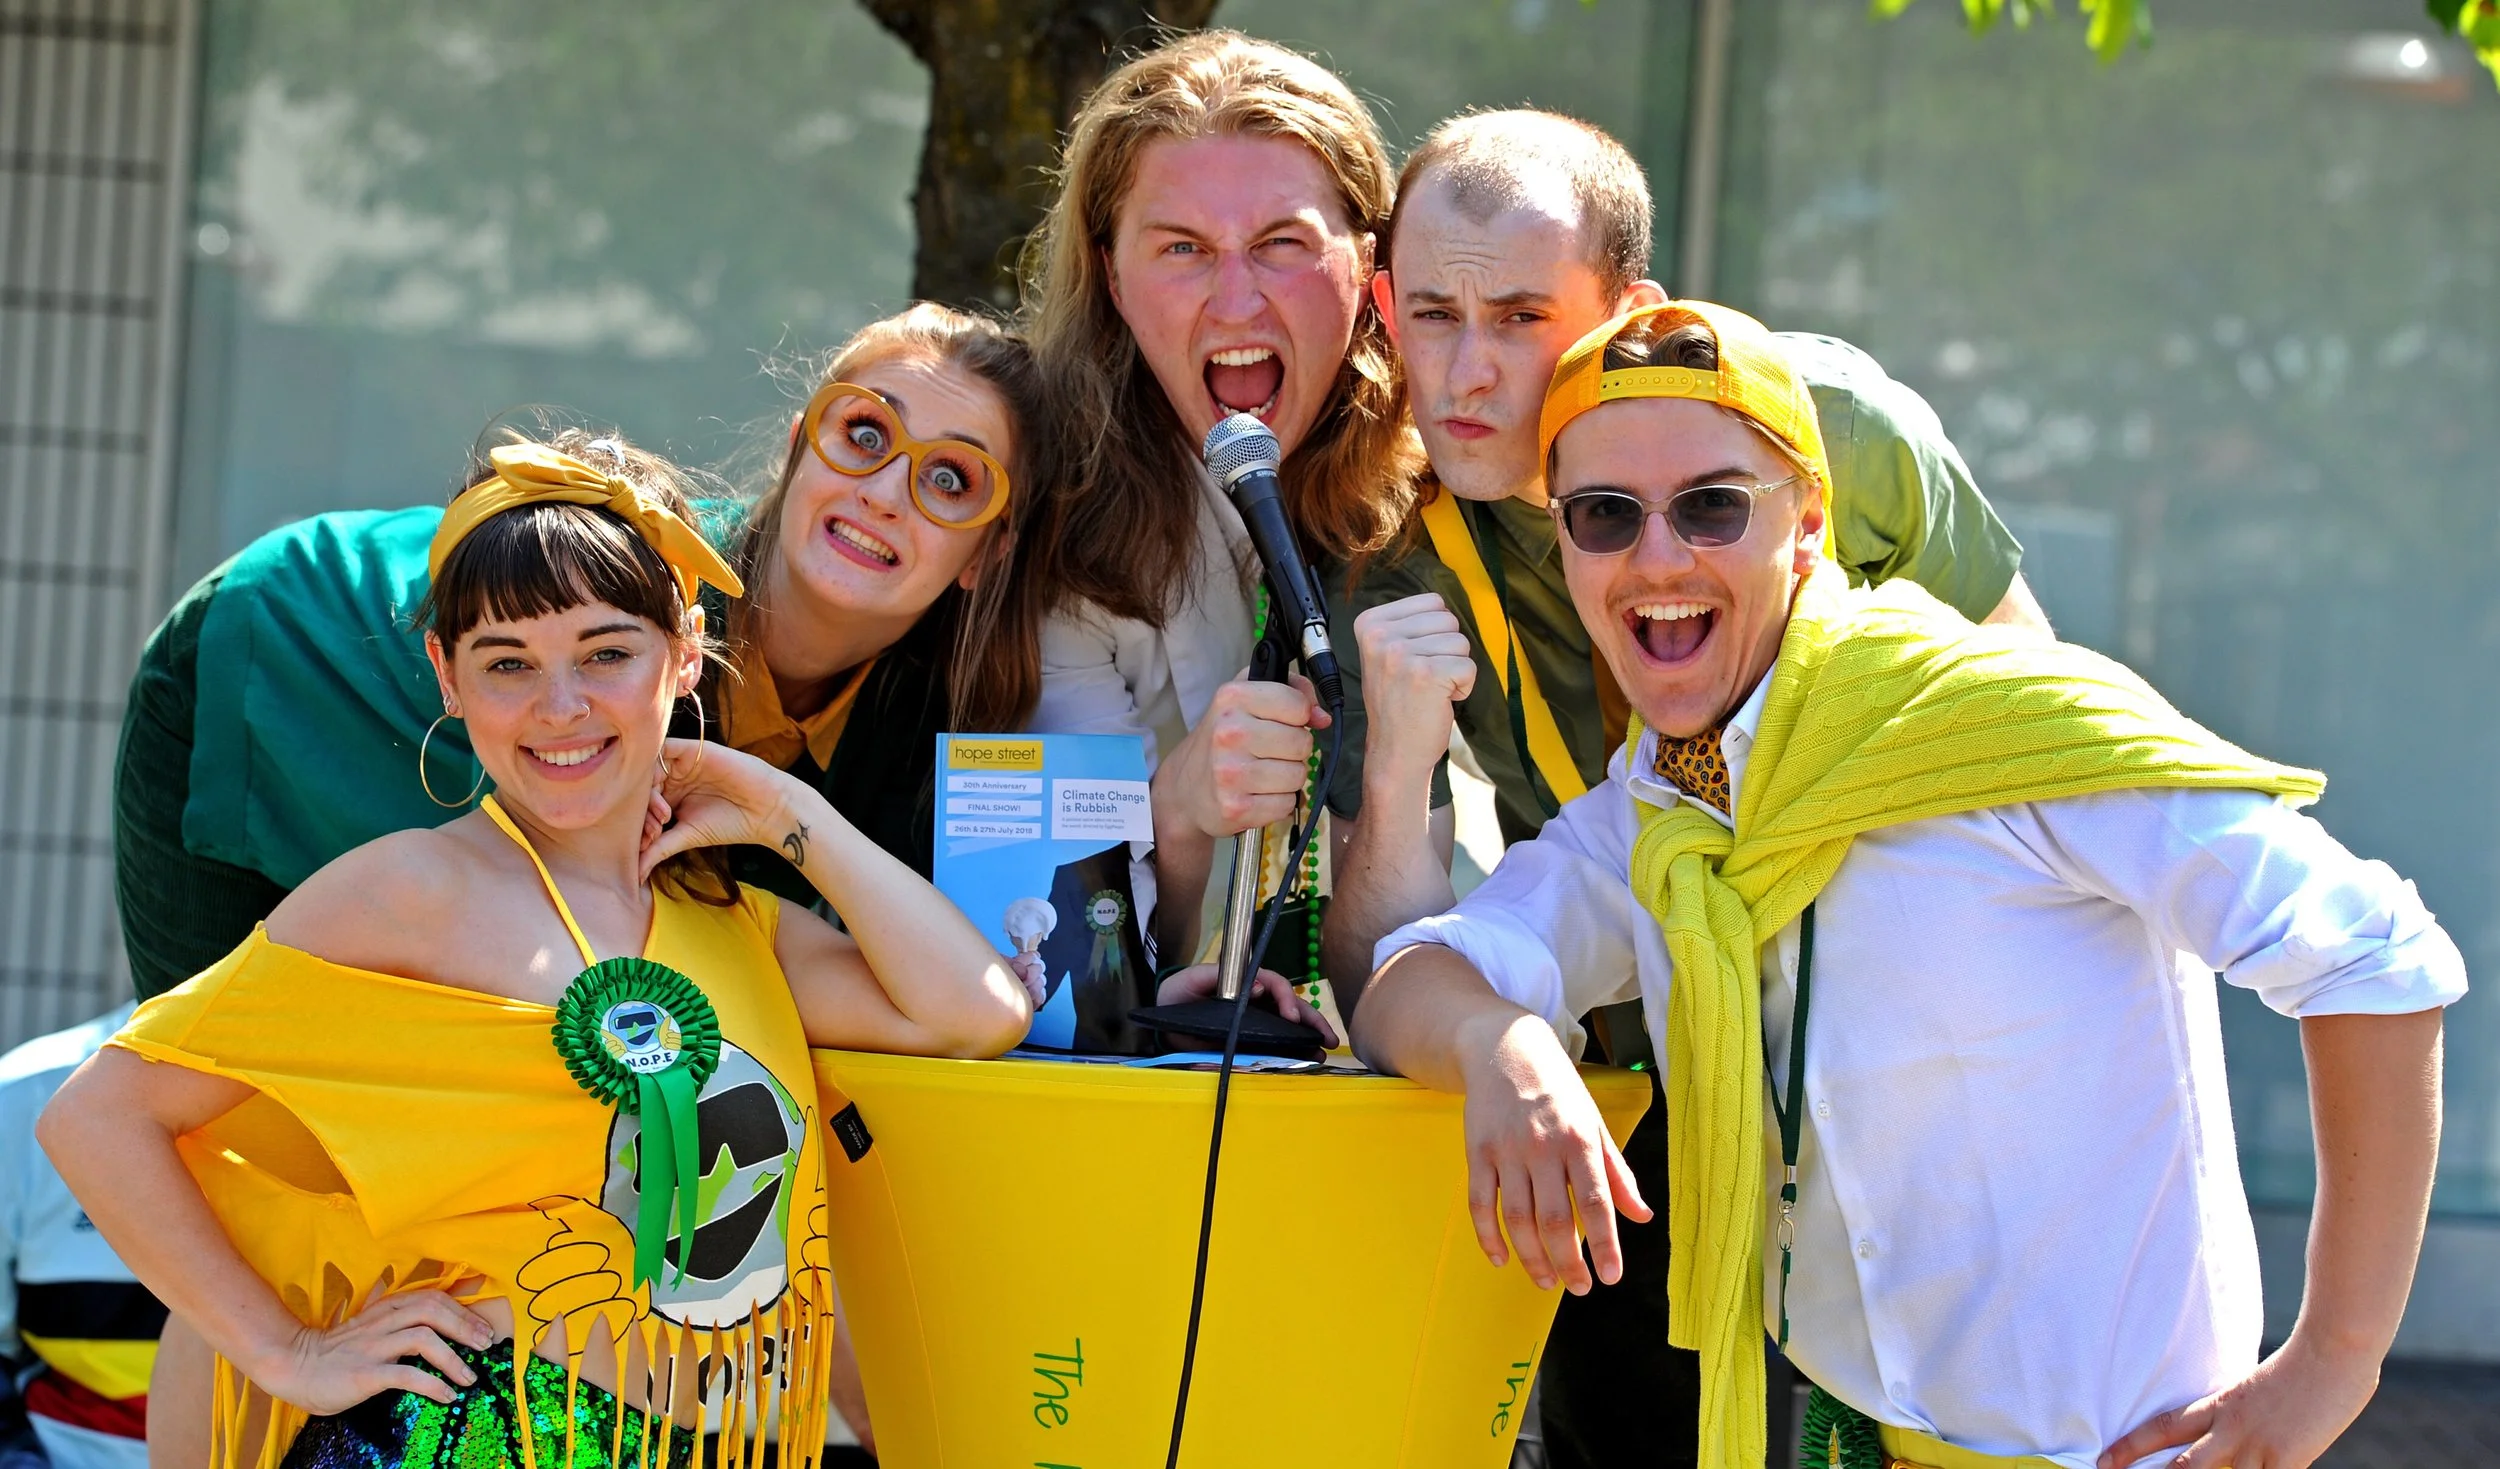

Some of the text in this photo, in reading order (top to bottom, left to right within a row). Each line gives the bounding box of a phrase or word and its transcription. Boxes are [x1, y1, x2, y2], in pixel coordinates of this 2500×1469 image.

[955, 746, 1036, 764] hope street
[963, 781, 1027, 791] 30th Anniversary
[1062, 789, 1146, 805] Climate Change
[967, 803, 1021, 812] FINAL SHOW!
[1062, 802, 1118, 813] is Rubbish
[954, 825, 972, 833] 26th
[997, 827, 1014, 835] July
[625, 1052, 673, 1068] N.O.P.E
[1033, 1338, 1084, 1429] The
[1491, 1341, 1538, 1438] The
